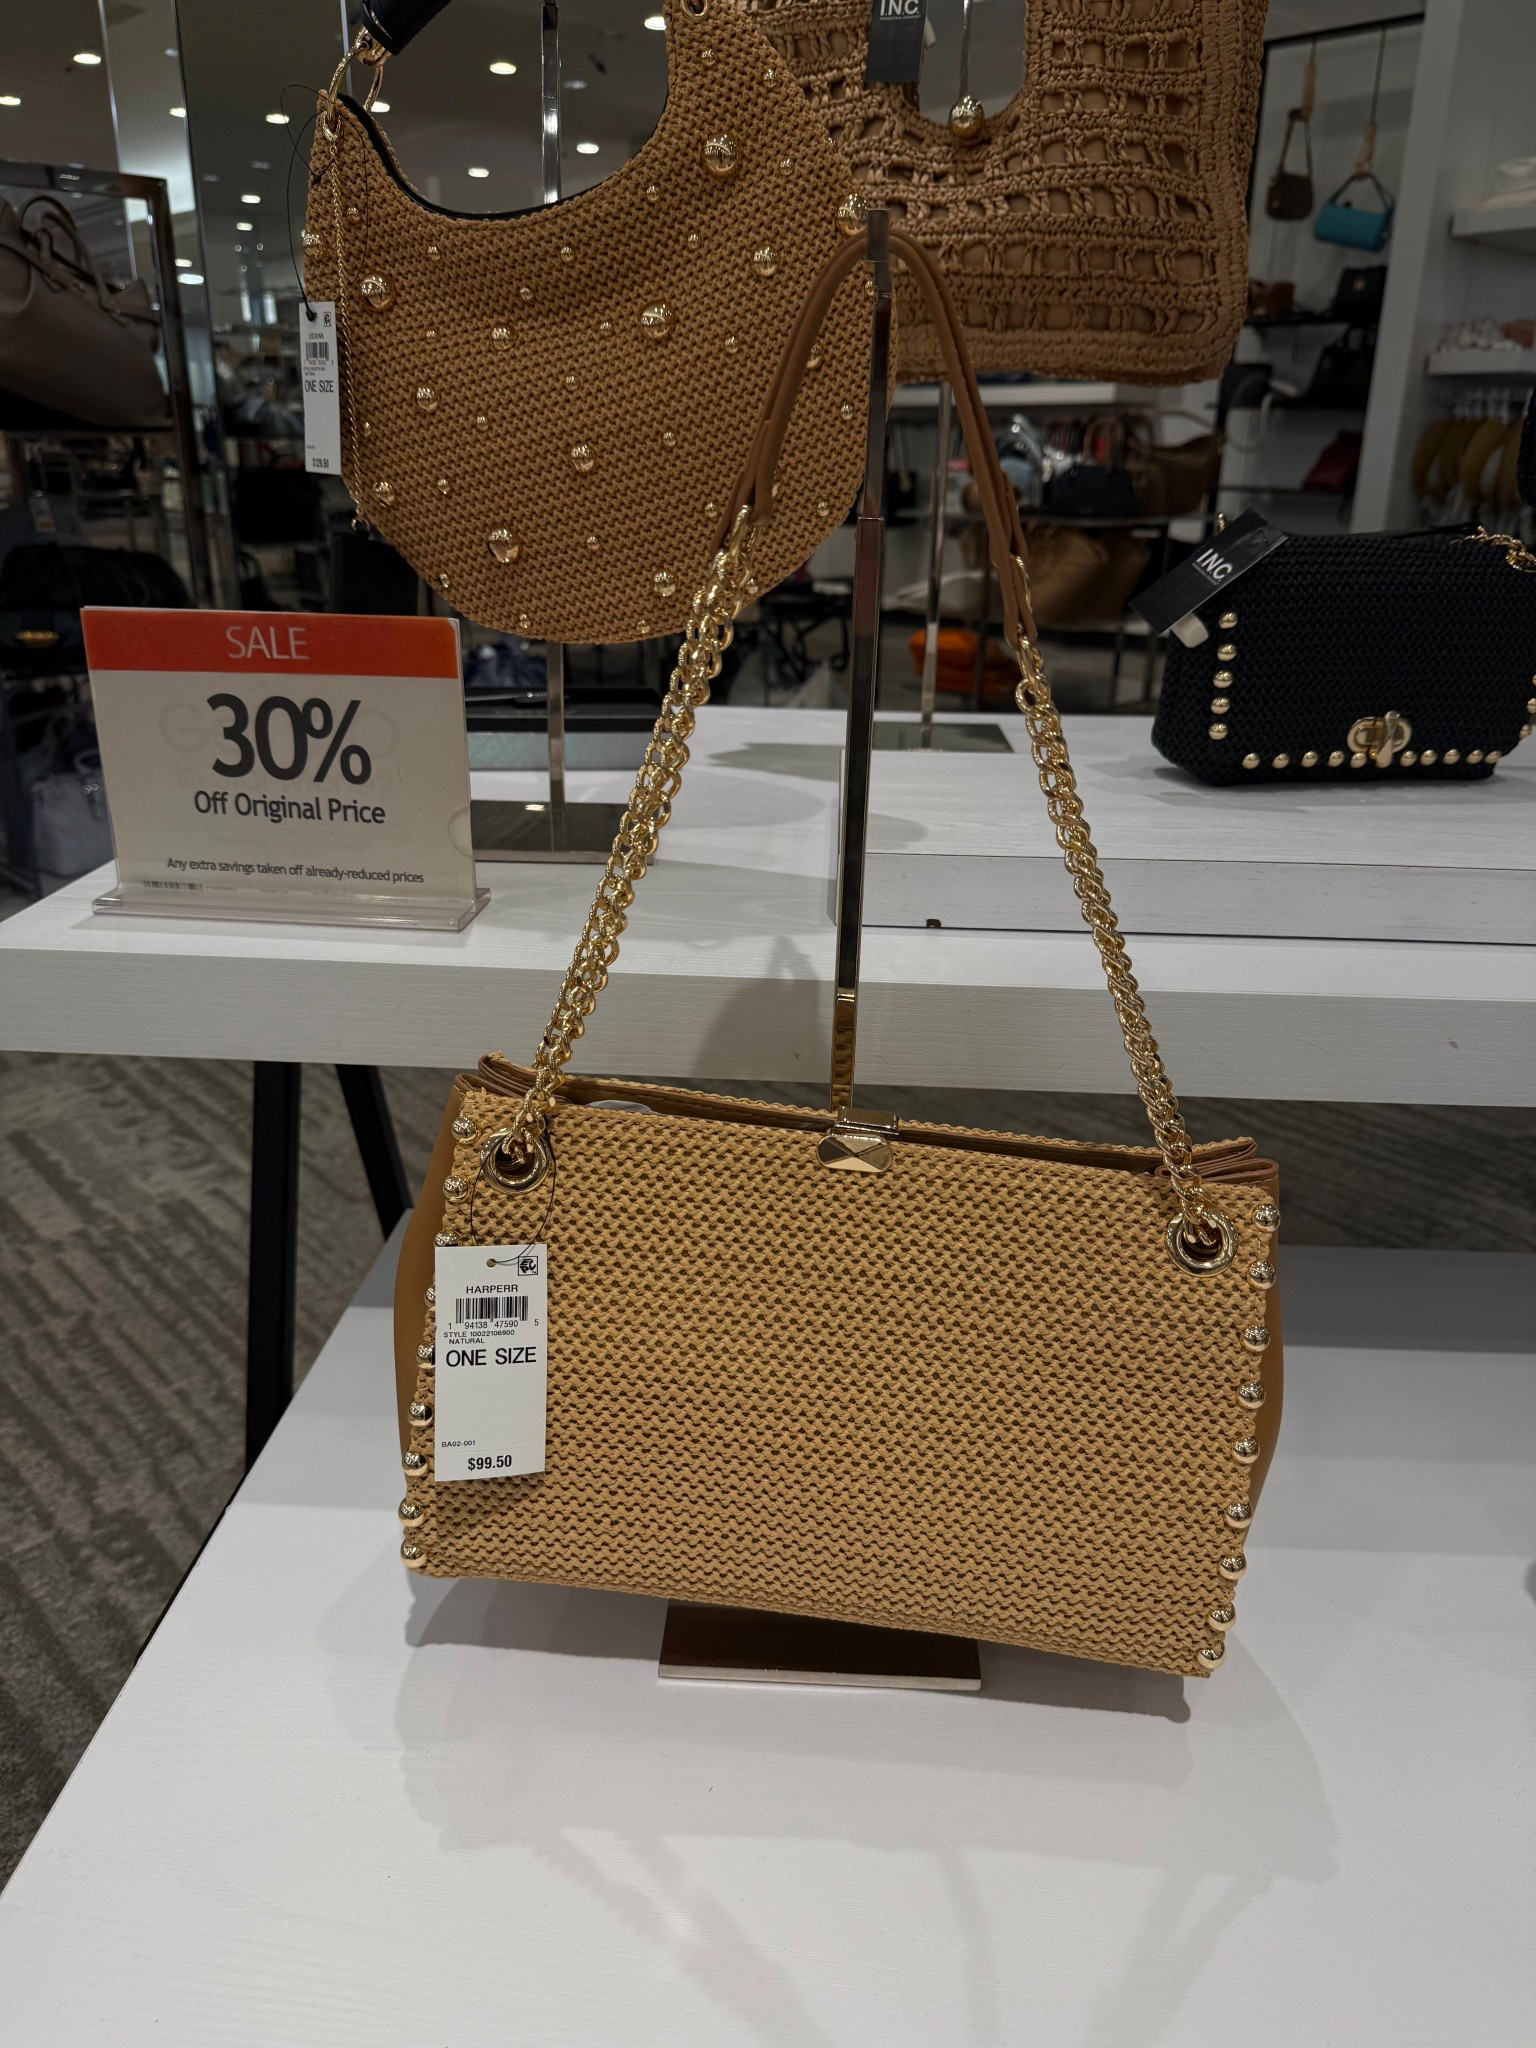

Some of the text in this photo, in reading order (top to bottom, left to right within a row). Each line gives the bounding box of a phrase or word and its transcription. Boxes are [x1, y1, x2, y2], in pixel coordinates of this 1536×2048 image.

[305, 380, 334, 394] ONE SIZE
[226, 626, 309, 660] SALE
[206, 693, 372, 785] 30%
[195, 790, 386, 824] Off Original Price
[167, 858, 424, 884] Any extra savings taken off already-reduced prices
[466, 1284, 519, 1294] HARPERR
[448, 1322, 452, 1330] 1
[494, 1320, 519, 1328] 47590
[470, 1329, 515, 1337] 10022106900
[446, 1346, 537, 1367] ONE SIZE
[441, 1440, 476, 1448] BA02-001
[467, 1455, 512, 1471] $99.50
